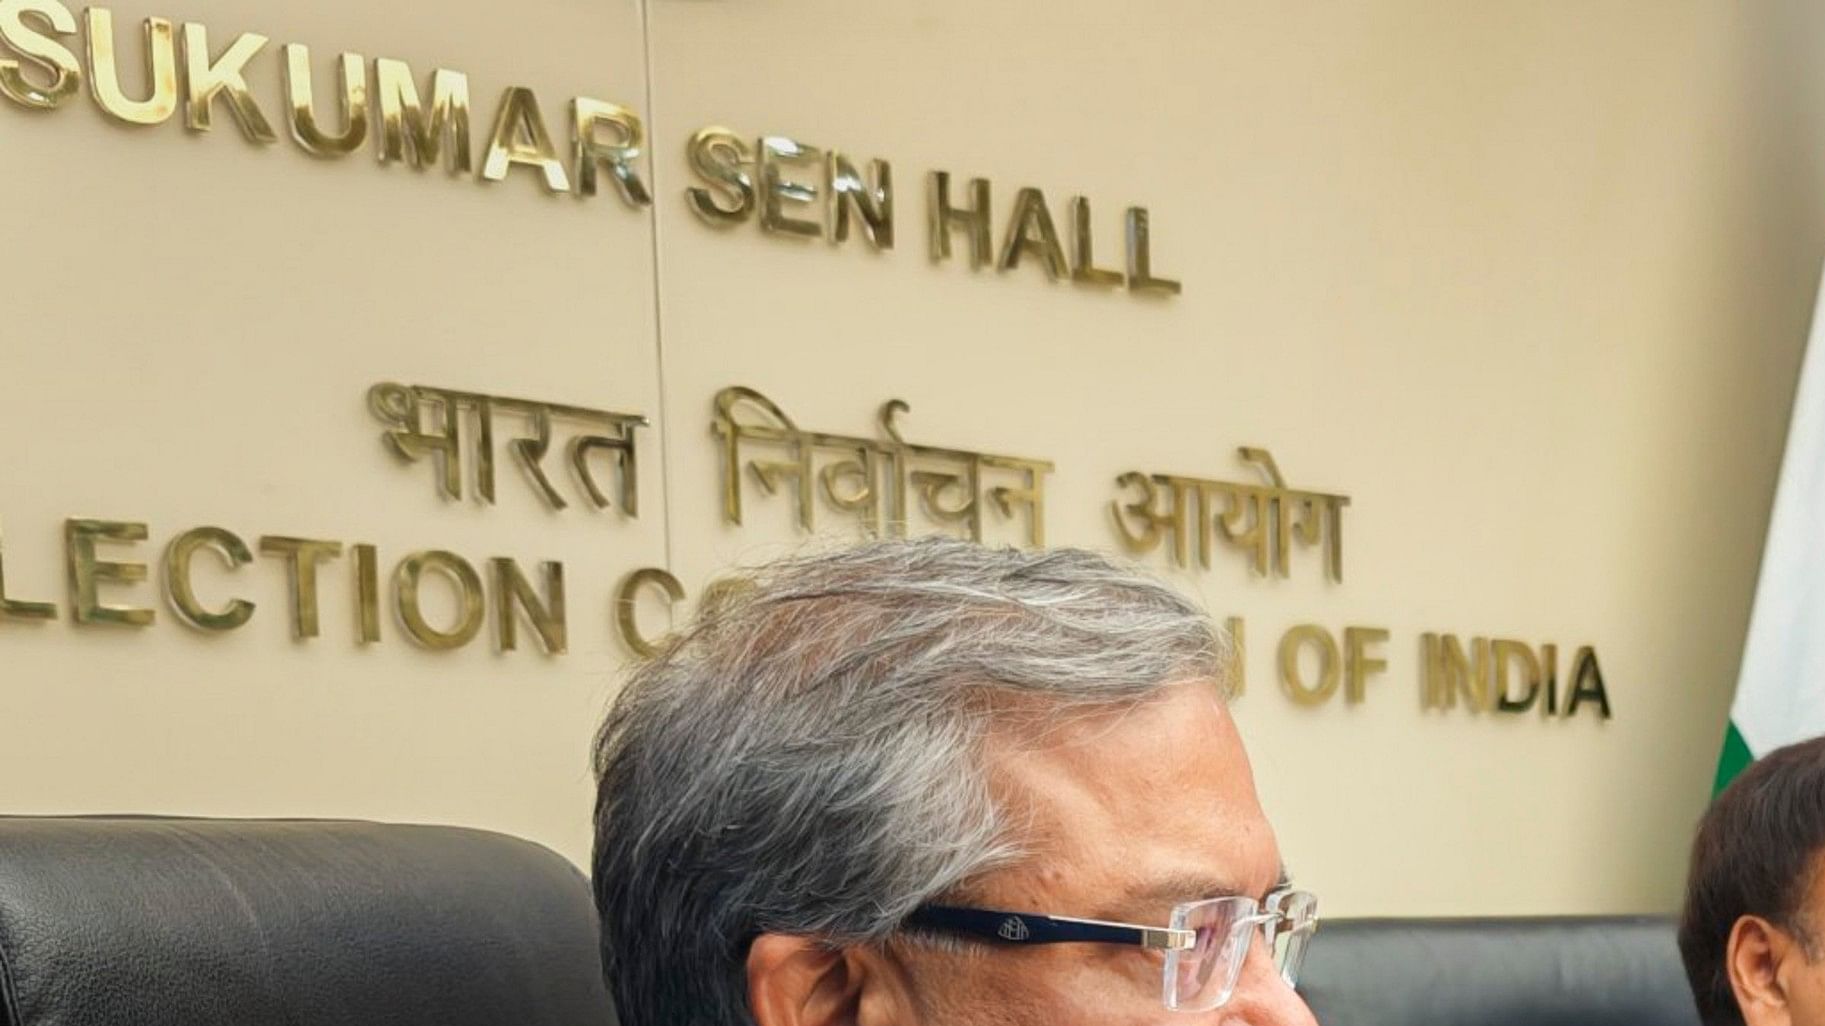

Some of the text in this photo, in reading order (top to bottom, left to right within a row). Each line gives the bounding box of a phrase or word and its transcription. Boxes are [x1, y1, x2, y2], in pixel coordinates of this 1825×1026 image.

[0, 0, 1182, 297] SUKUMAR SEN HALL
[367, 382, 1352, 584] भारत निर्वाचन आयोग
[1277, 623, 1390, 708] OF
[1420, 632, 1613, 720] INDIA
